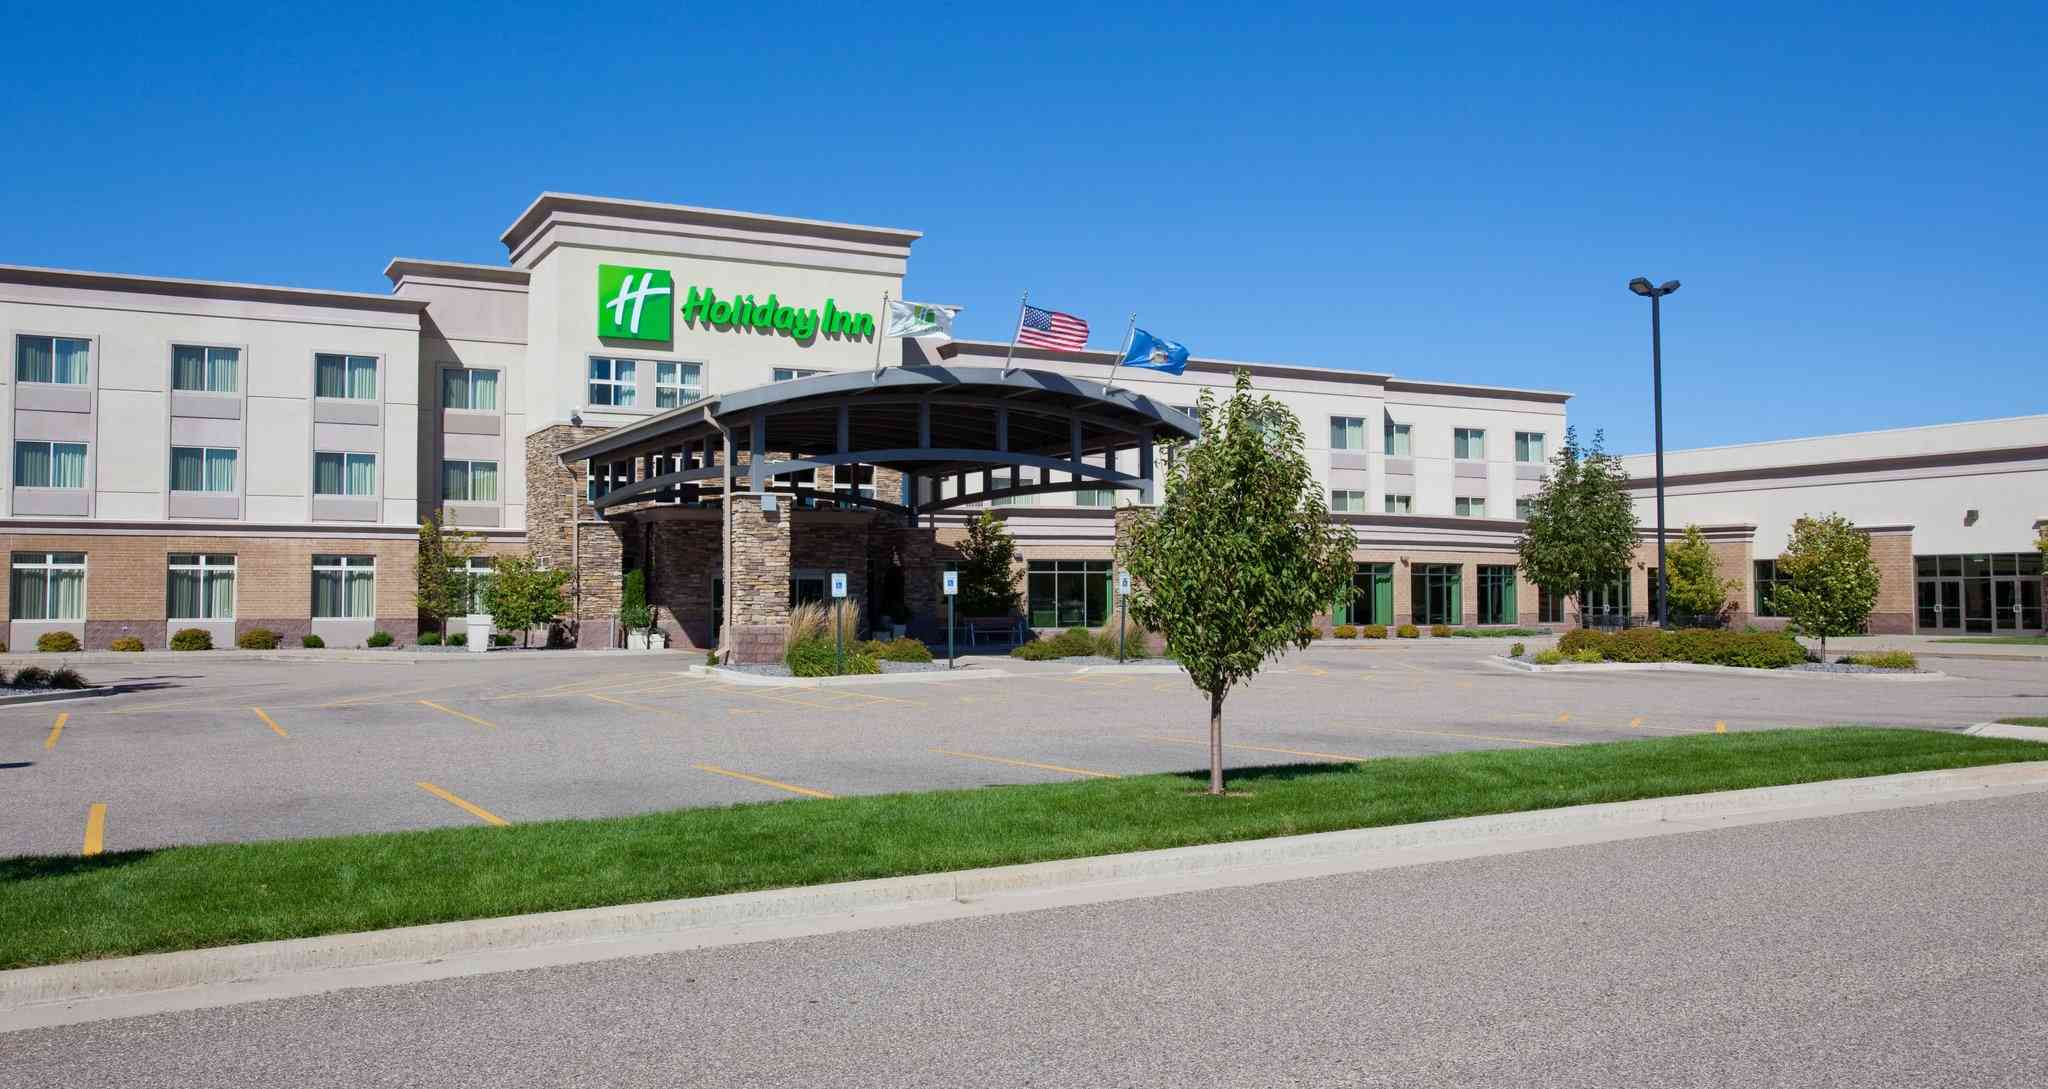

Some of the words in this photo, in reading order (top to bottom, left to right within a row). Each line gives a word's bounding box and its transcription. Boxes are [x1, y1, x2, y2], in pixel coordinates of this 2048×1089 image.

[606, 272, 671, 333] H
[682, 286, 819, 341] Holiday
[821, 298, 874, 338] Inn
